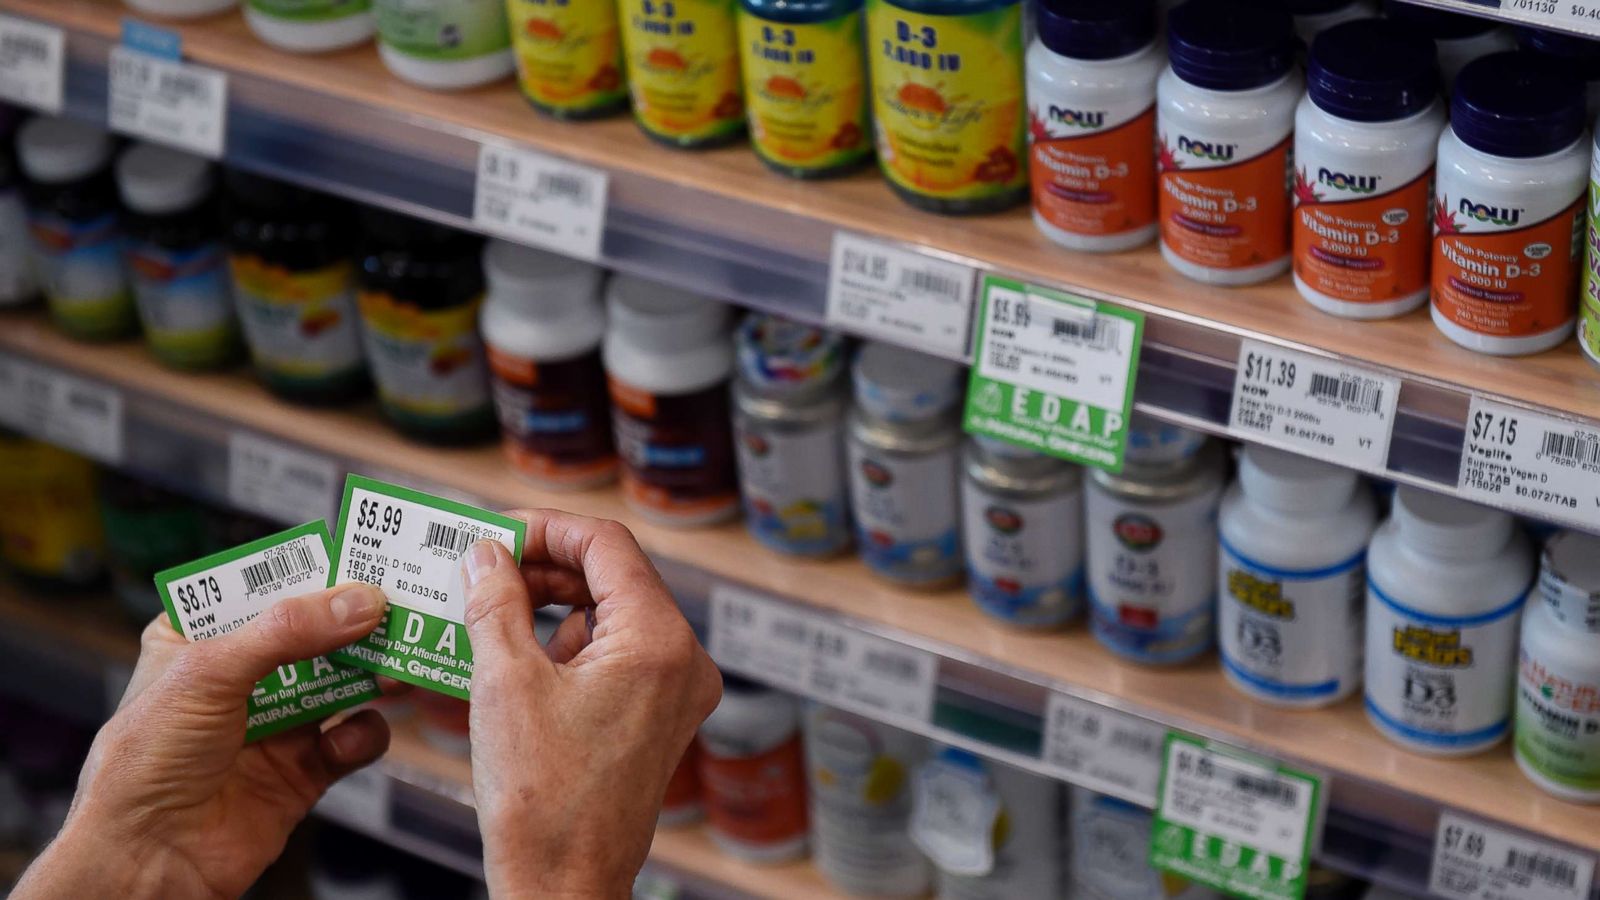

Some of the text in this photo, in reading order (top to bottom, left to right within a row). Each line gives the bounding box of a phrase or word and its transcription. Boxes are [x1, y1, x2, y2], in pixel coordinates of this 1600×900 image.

[896, 20, 937, 48] D-3
[1165, 177, 1257, 212] Vitamin D-3
[1302, 208, 1360, 245] Vitamin
[1365, 230, 1399, 245] D-3
[1441, 239, 1499, 278] Vitamin
[1506, 263, 1541, 278] D-3
[1455, 240, 1475, 256] High
[1477, 248, 1518, 264] Potency
[1461, 270, 1507, 289] 2,000 IU
[1245, 352, 1296, 389] $11.39
[1242, 384, 1269, 398] NOW
[1472, 409, 1518, 446] $7.15
[1359, 438, 1372, 450] VT
[1466, 468, 1510, 486] 100 TAB
[1467, 457, 1548, 484] Supreme Vegan D
[1516, 485, 1578, 508] $0.072/TAB
[357, 498, 402, 536] $5.99
[353, 533, 382, 549] NOW
[348, 559, 385, 577] 180 SG
[349, 547, 422, 575] Edap Vit. D 1000
[432, 549, 458, 561] 33739
[258, 582, 282, 596] 33739
[286, 571, 311, 586] 00372
[318, 566, 324, 575] 0
[346, 570, 448, 603] 138454 $0.033/SG
[177, 576, 222, 617] $8.79
[189, 613, 216, 631] NOW
[233, 618, 244, 629] D3
[343, 645, 405, 672] NATURAL
[369, 633, 392, 649] Every
[394, 641, 411, 655] Day
[412, 646, 456, 668] Affordable
[254, 693, 278, 708] Every
[279, 687, 296, 700] Day
[297, 673, 341, 693] Affordable
